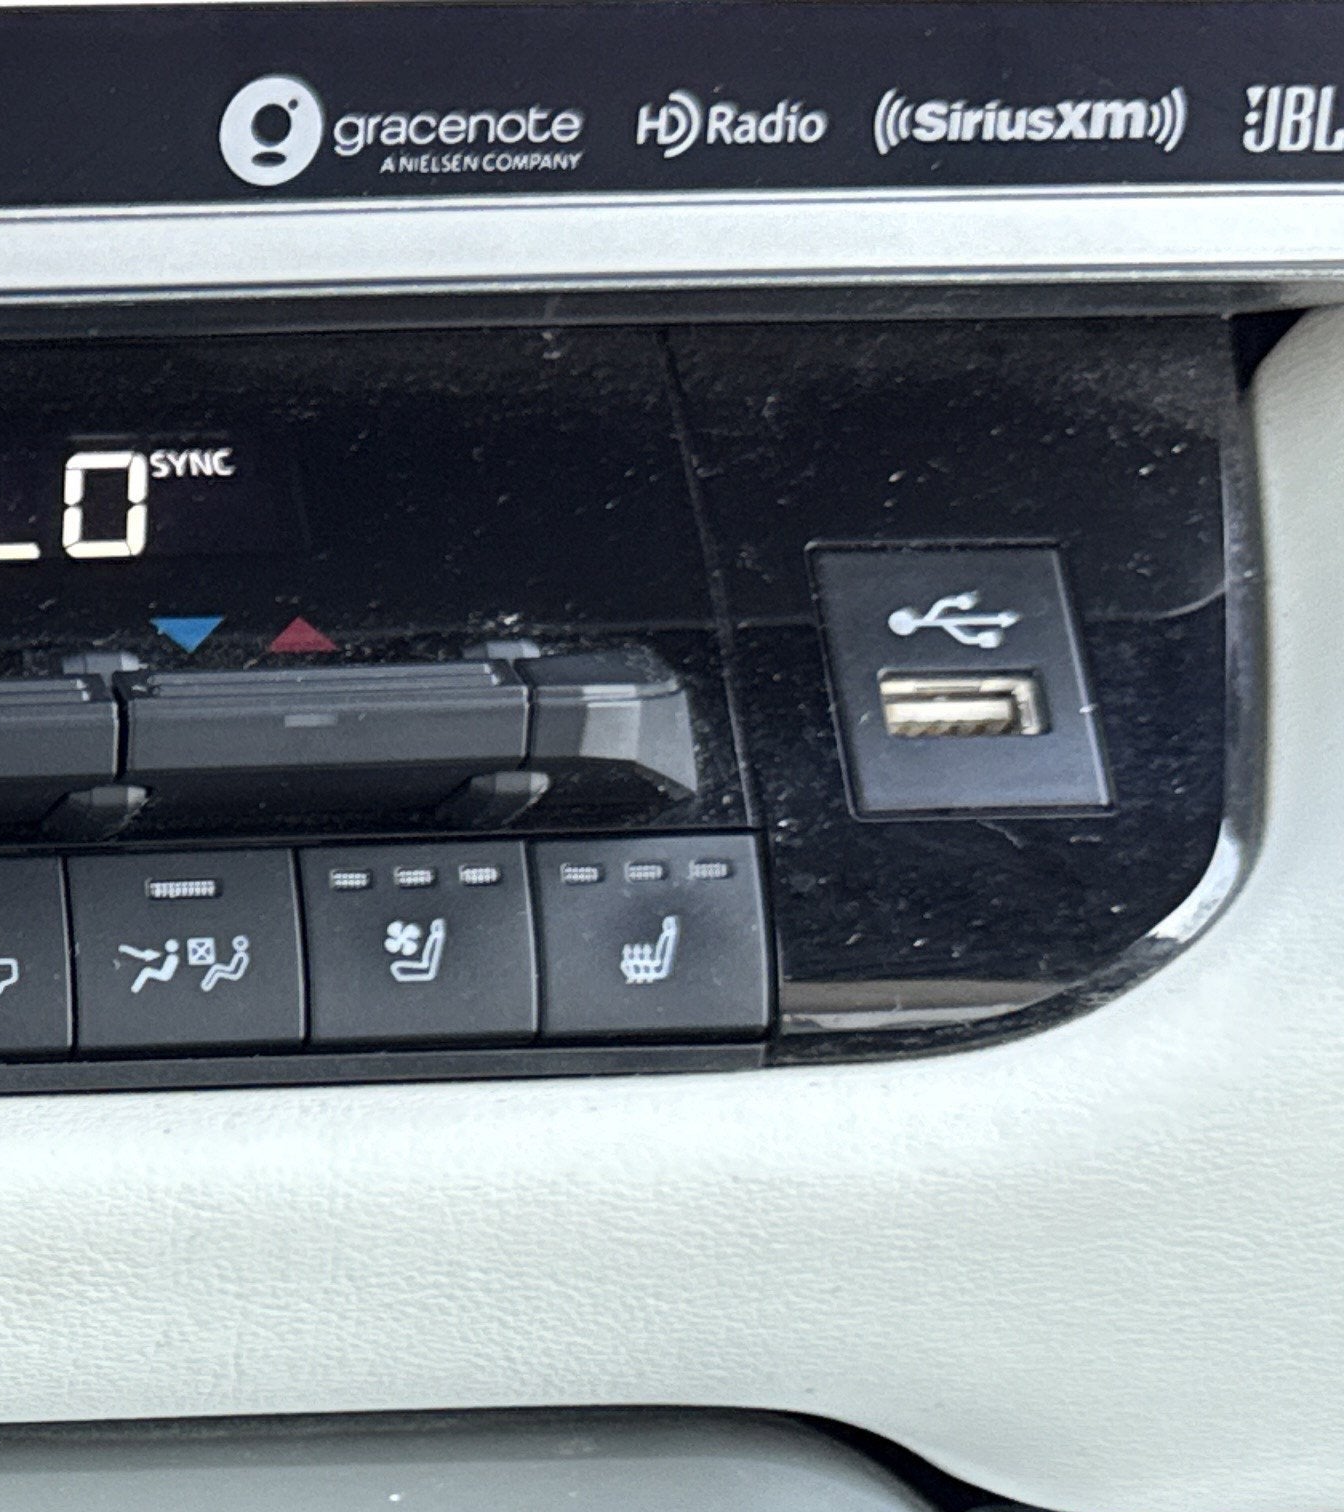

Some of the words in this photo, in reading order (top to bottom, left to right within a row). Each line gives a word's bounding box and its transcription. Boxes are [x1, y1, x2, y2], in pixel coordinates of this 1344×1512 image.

[333, 106, 582, 157] gracenote
[706, 101, 828, 144] Radio
[1243, 85, 1344, 153] JBL
[379, 156, 394, 174] A
[399, 153, 479, 174] NIELSEN
[481, 151, 582, 173] COMPANY
[149, 449, 234, 478] SYNC
